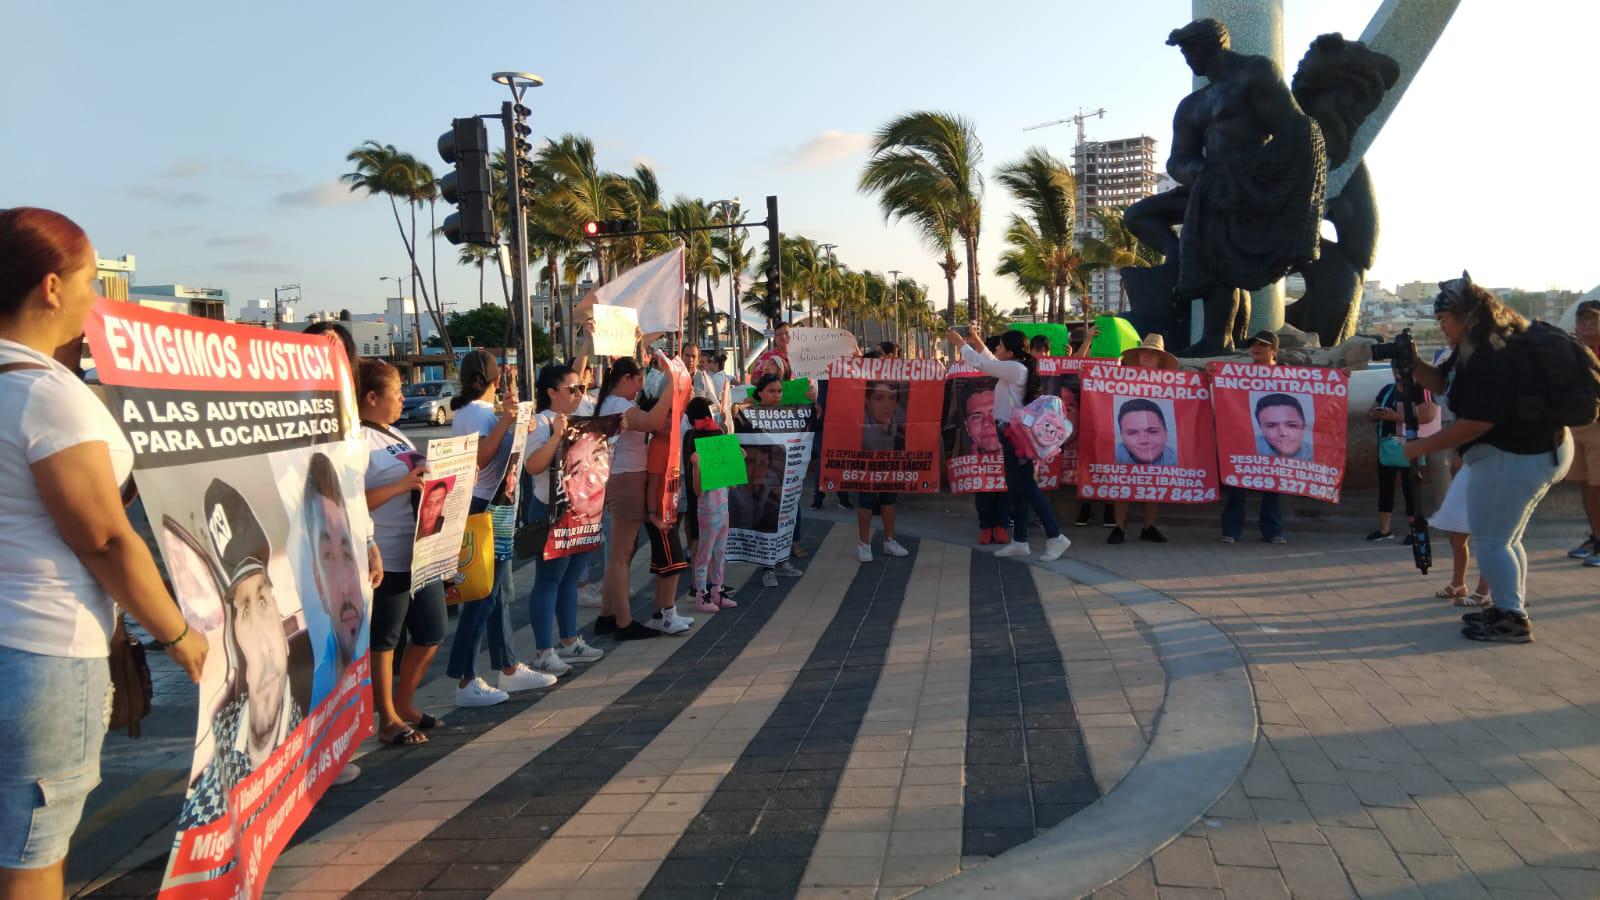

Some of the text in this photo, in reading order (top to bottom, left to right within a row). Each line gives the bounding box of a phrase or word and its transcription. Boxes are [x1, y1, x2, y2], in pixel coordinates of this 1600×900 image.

[103, 314, 335, 381] EXIGIMOS JUSTICIA
[831, 357, 945, 381] DESAPARECIDO
[1090, 365, 1201, 387] AYUDANOS A
[1221, 363, 1341, 382] AYUDANOS A
[1083, 378, 1209, 400] ENCONTRARLO
[1215, 377, 1347, 397] ENCONTRARLO
[123, 400, 144, 423] A
[150, 400, 200, 423] LAS
[744, 408, 812, 420] SE BUSCA SU
[752, 419, 806, 430] PARADERO
[130, 428, 204, 454] PARA
[1089, 463, 1206, 479] JESUS ALEJANDRO
[1230, 455, 1338, 476] JESUS ALEJANDRO
[1235, 464, 1294, 478] SANCHEZ
[843, 470, 919, 481] 667 157 1930
[986, 476, 1007, 489] 32
[1092, 475, 1204, 488] SANCHEZ IBARRA
[1097, 485, 1216, 501] 669 327 8424
[1242, 476, 1275, 489] 669
[1279, 478, 1306, 494] 327
